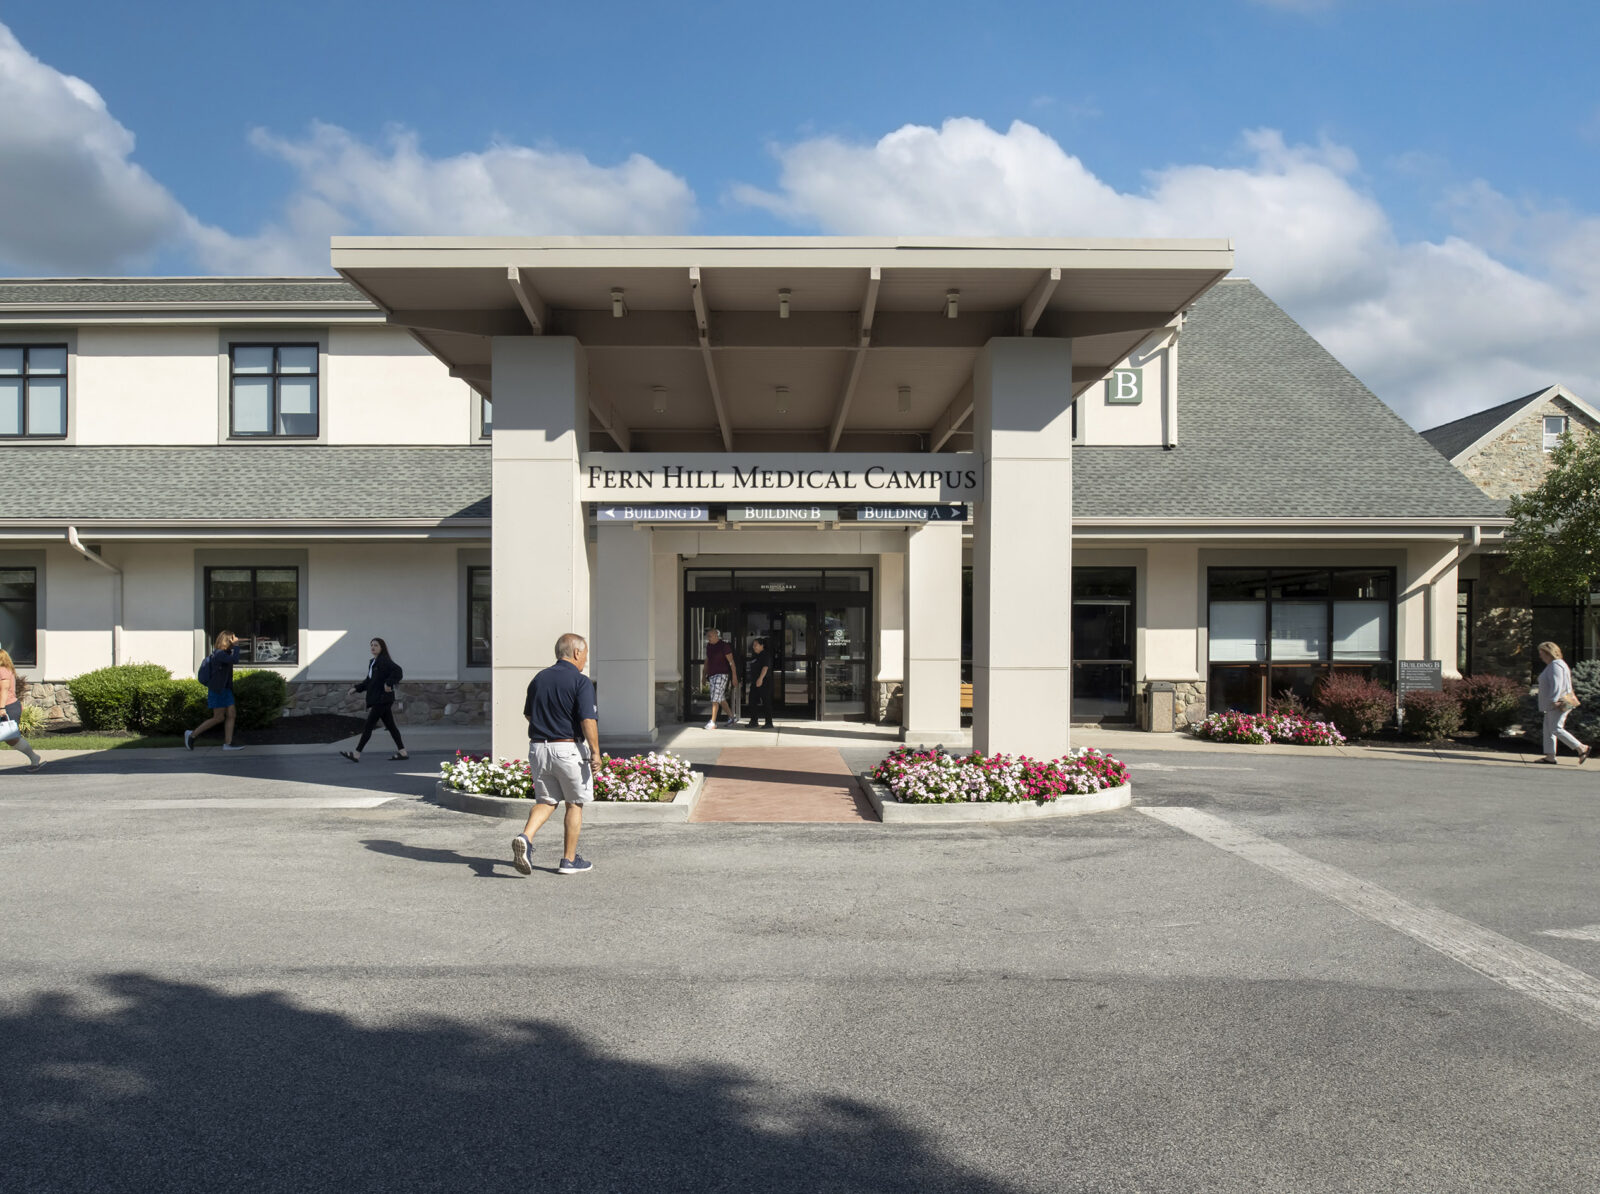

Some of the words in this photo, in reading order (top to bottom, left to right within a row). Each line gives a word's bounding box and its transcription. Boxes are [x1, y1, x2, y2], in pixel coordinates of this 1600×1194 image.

[1114, 371, 1138, 399] B
[588, 466, 654, 488] FERN
[662, 466, 724, 489] HILL
[732, 466, 857, 489] MEDICAL
[864, 466, 976, 489] CAMPUS
[624, 507, 686, 519] BUILDING
[690, 507, 702, 519] D
[744, 507, 807, 519] BUILDING
[811, 507, 821, 519] B
[864, 507, 928, 519] BUILDING
[930, 507, 941, 519] A
